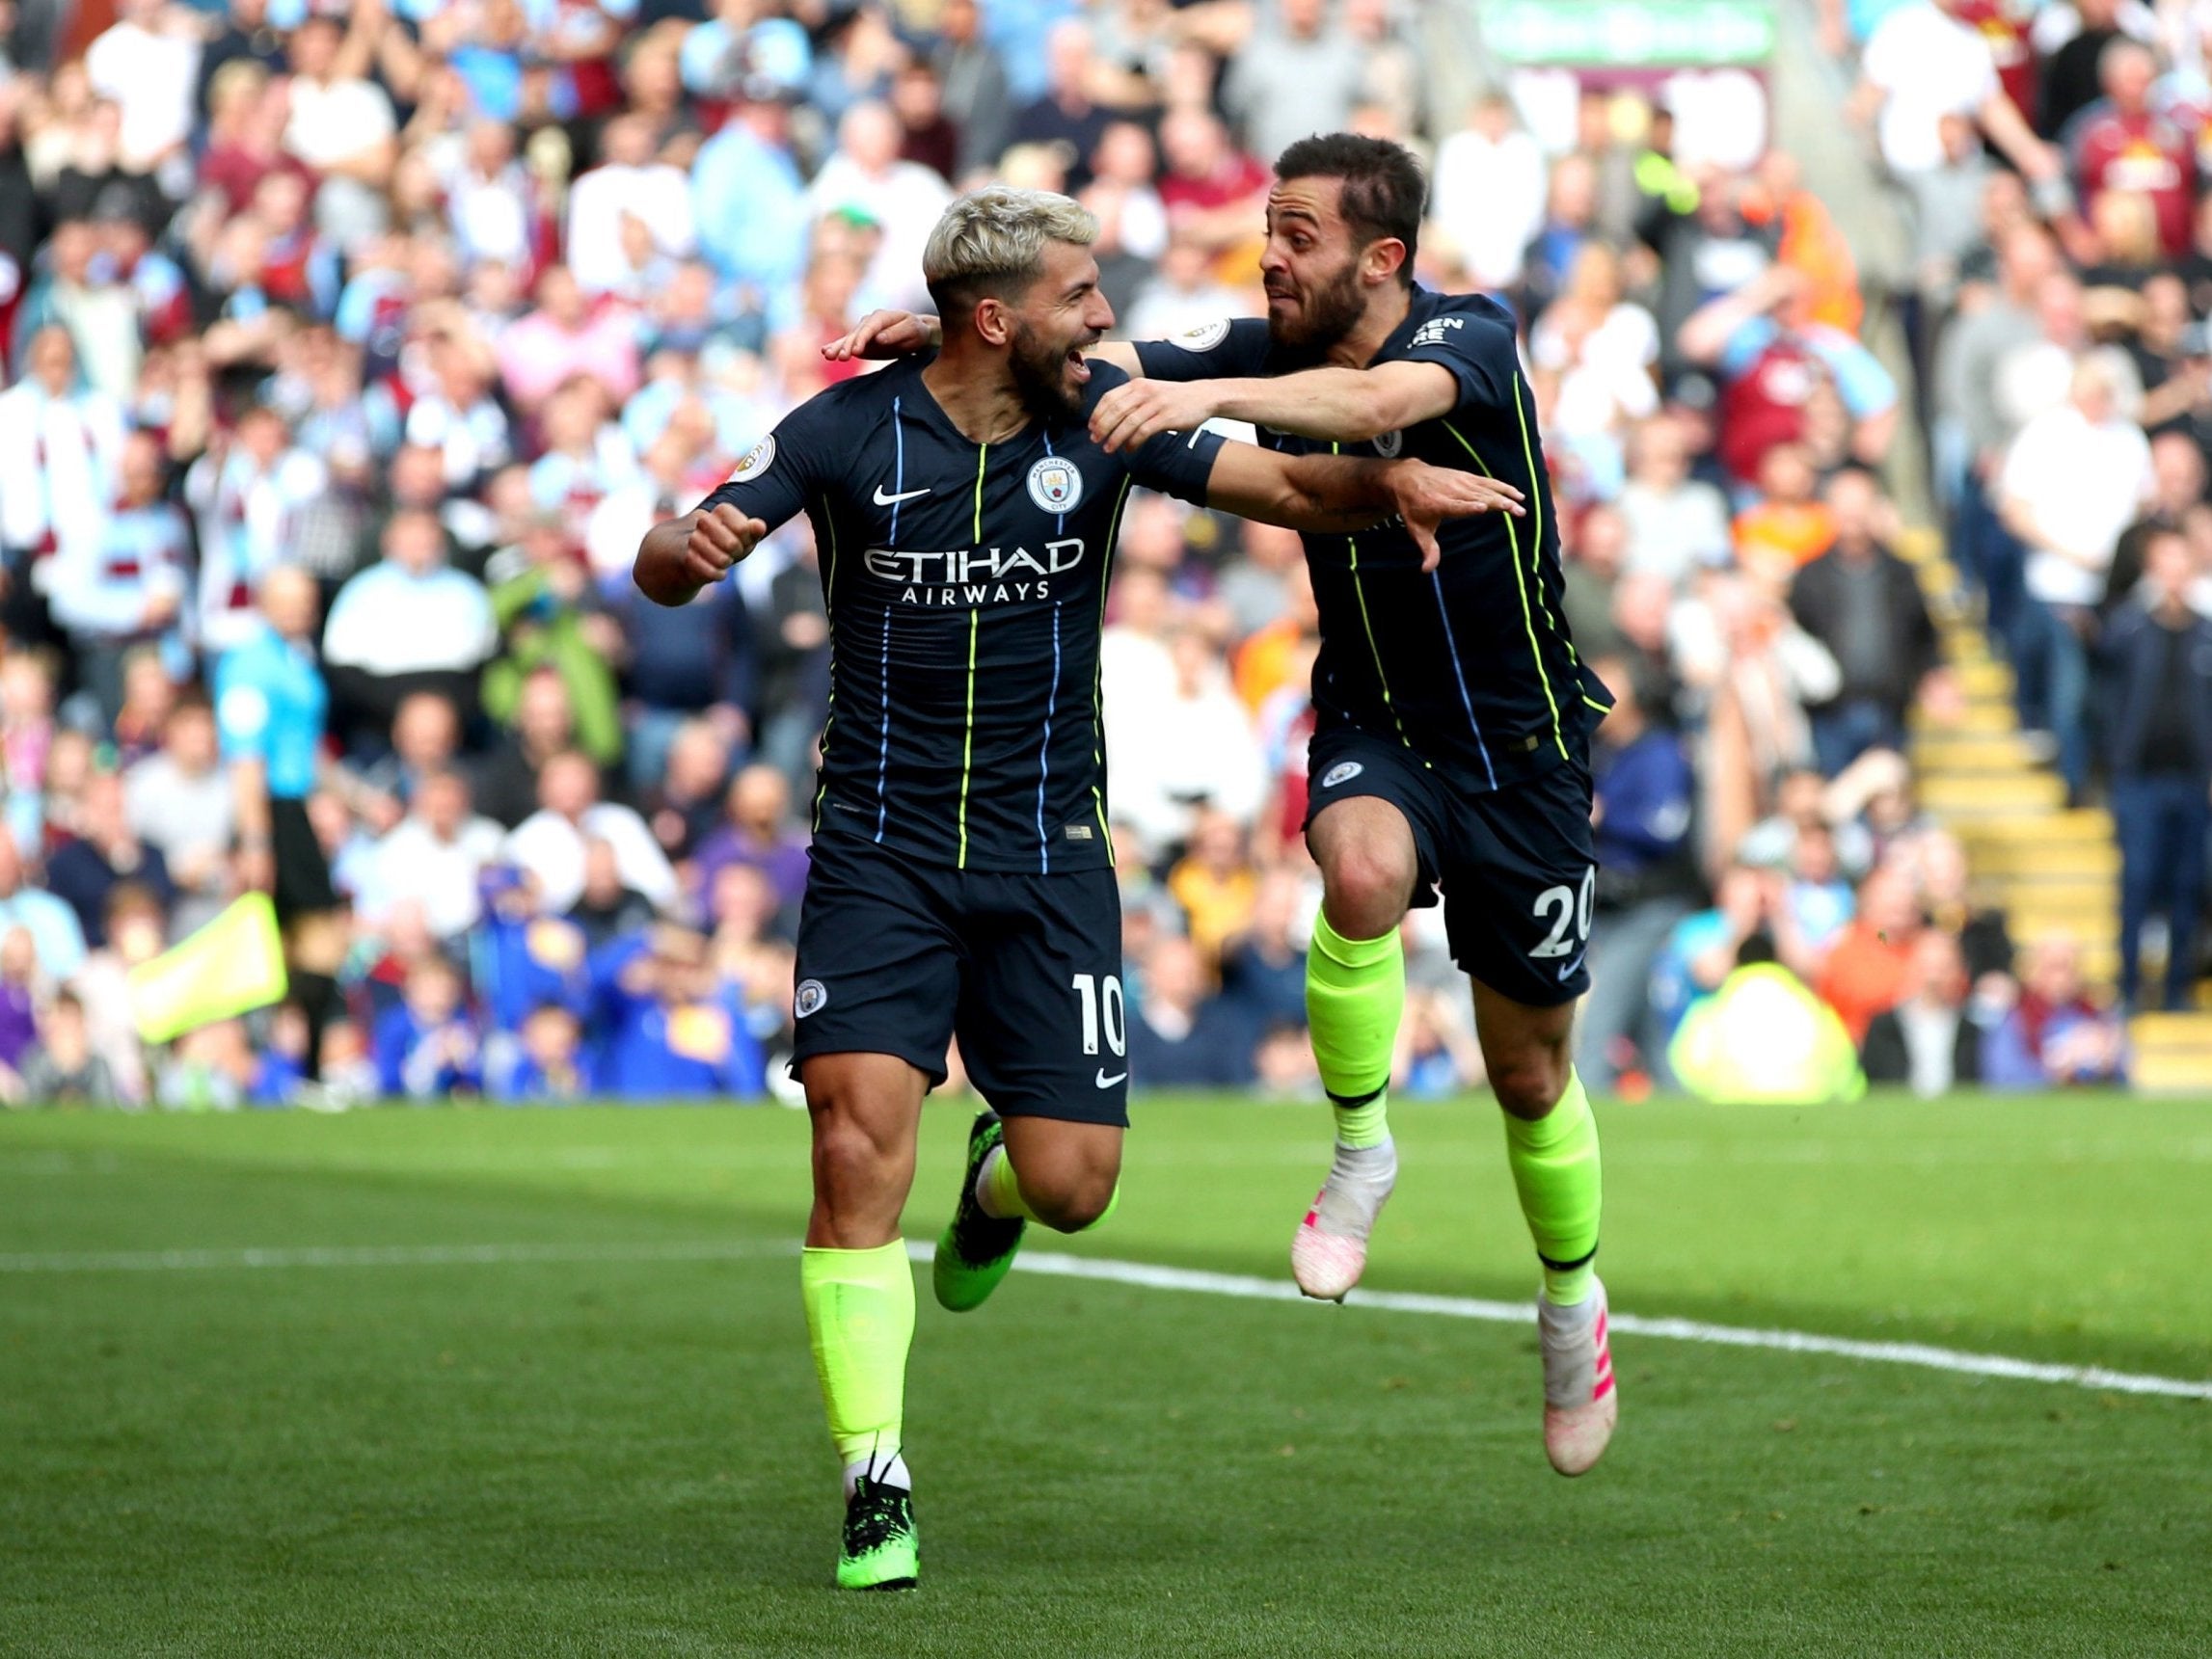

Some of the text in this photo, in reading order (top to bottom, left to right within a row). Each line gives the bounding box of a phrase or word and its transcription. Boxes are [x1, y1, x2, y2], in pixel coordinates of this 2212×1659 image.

[1032, 459, 1075, 479] MANCHESTER
[864, 538, 1085, 583] ETIHAD
[902, 580, 1049, 605] AIRWAYS
[1528, 864, 1595, 957] 20
[1072, 973, 1125, 1057] 10
